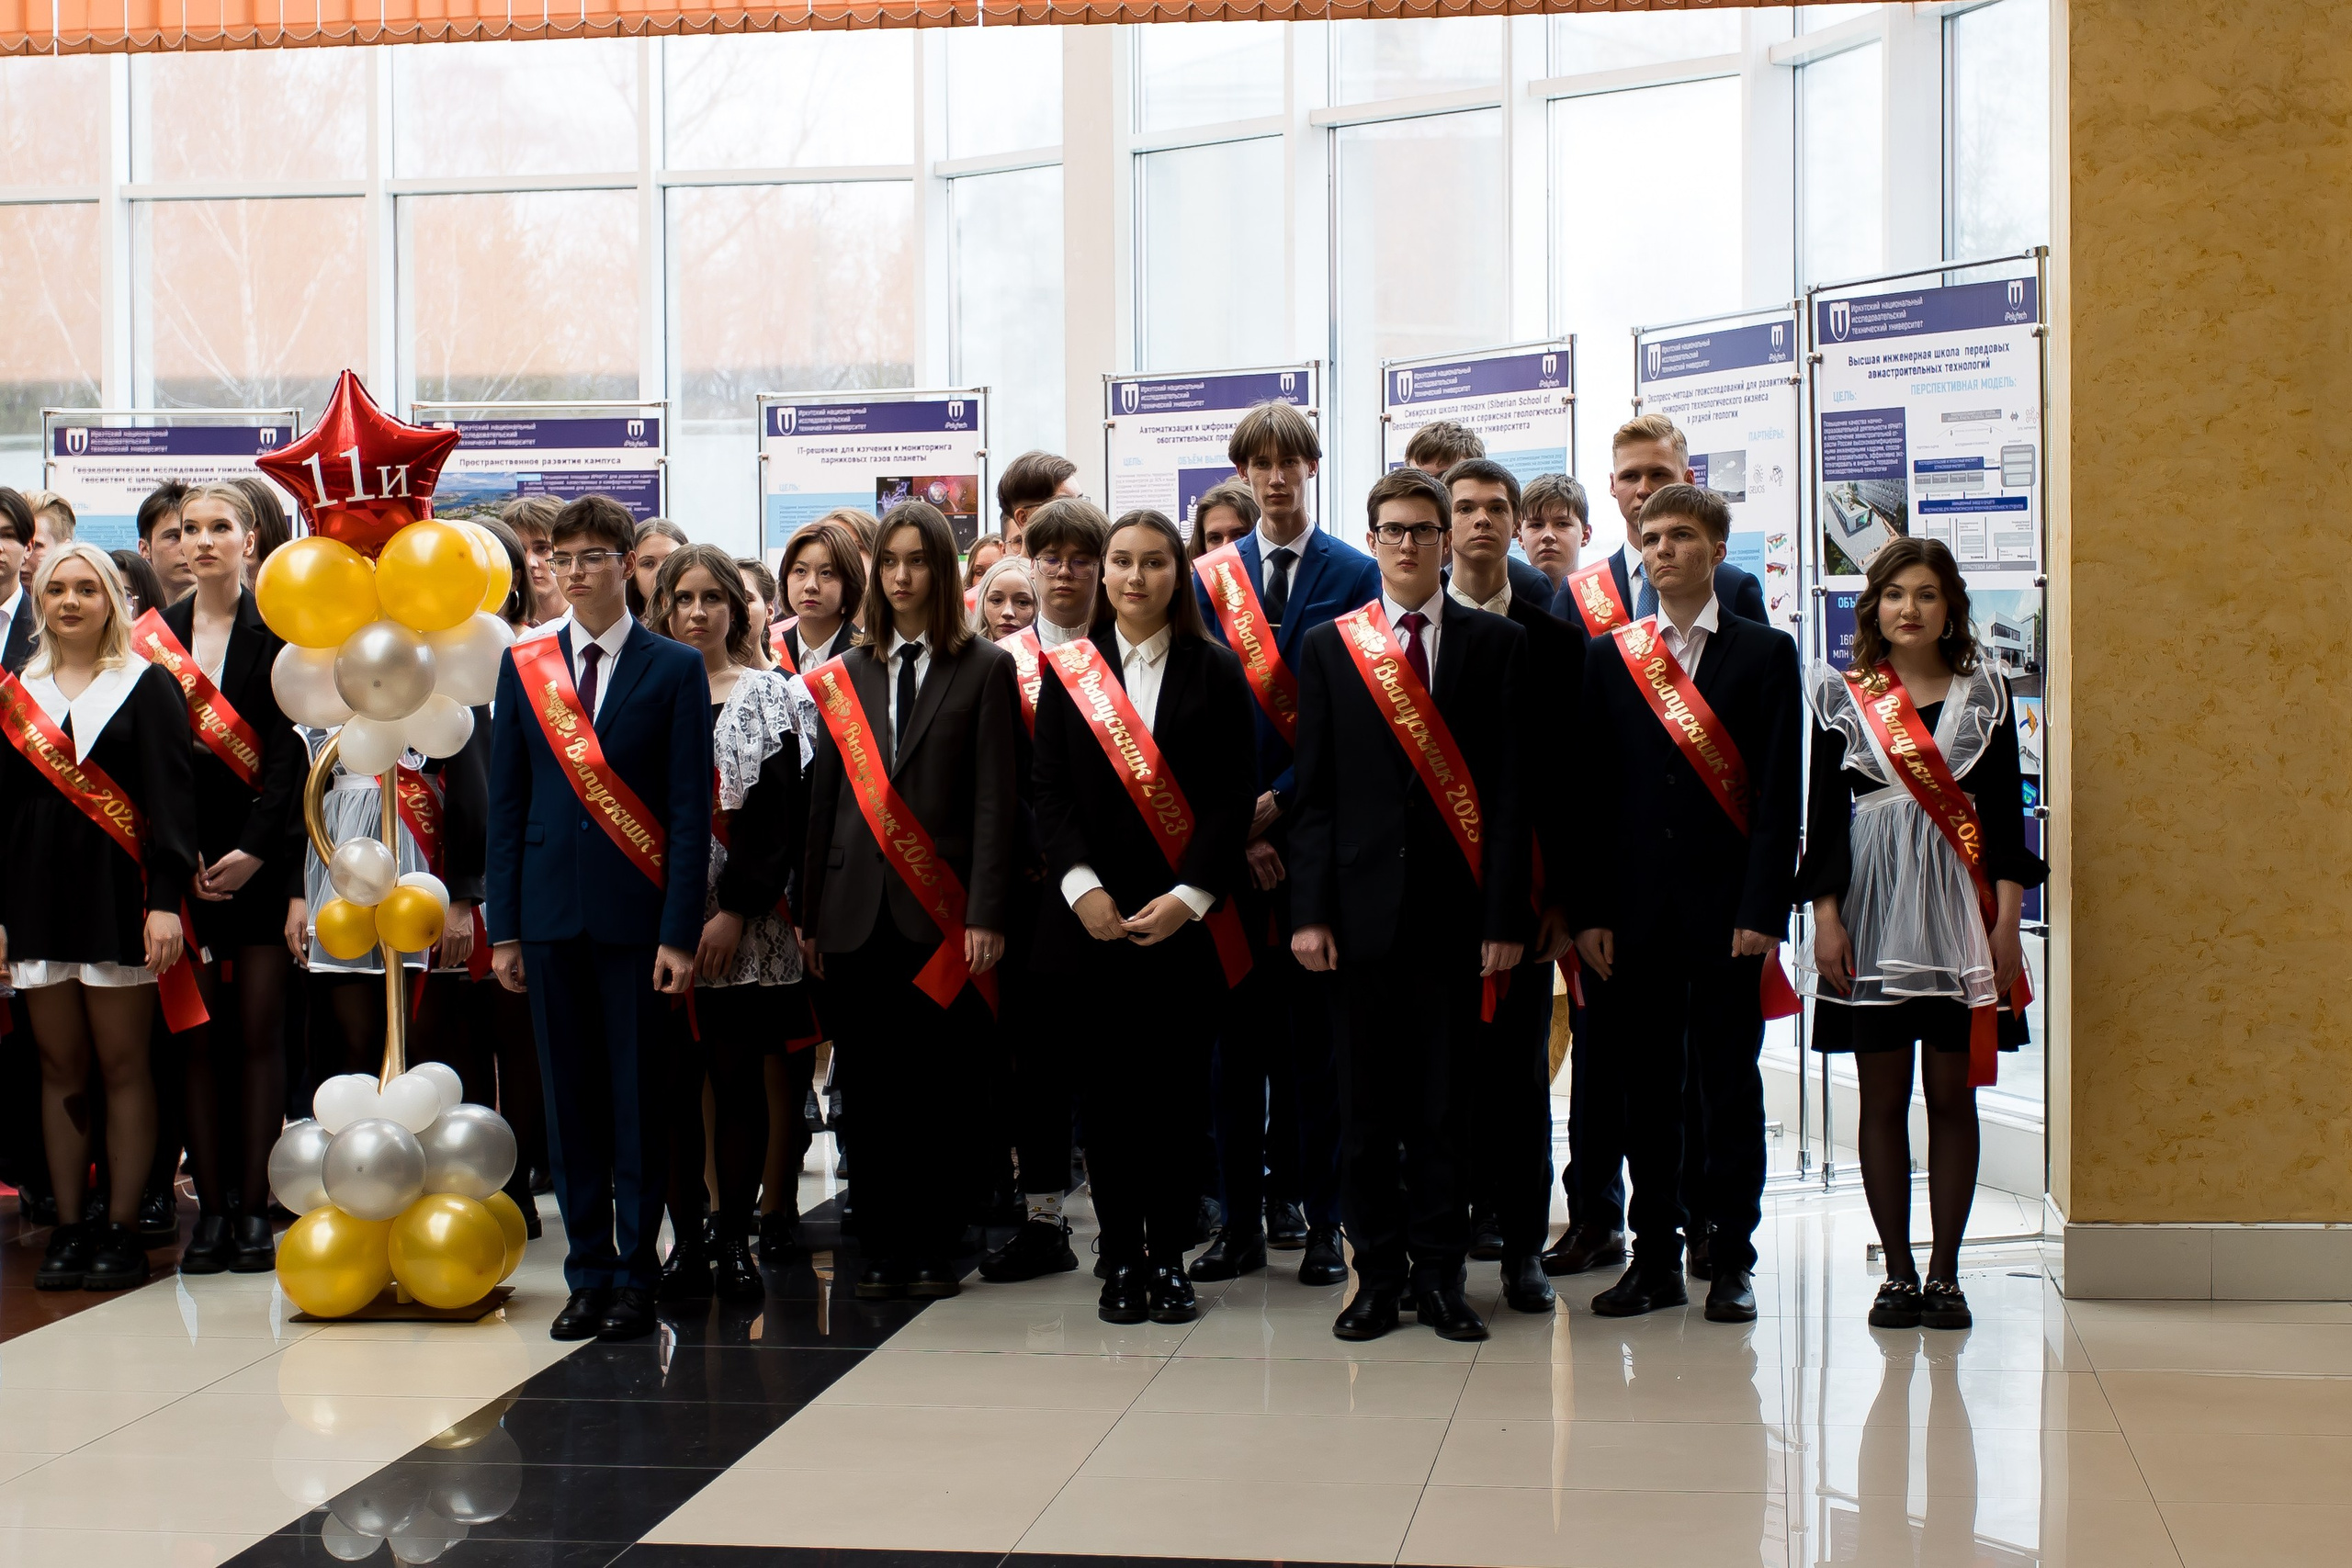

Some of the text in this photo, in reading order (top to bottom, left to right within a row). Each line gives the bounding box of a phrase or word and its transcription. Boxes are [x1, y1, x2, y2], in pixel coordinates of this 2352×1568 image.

[1850, 296, 1924, 313] Иркутский национальный
[1850, 309, 1907, 323] исследовательский
[2005, 310, 2028, 323] iPolytech
[1851, 320, 1924, 335] технический университет
[1848, 342, 2010, 367] Высшая инженерная школа передовых
[1868, 356, 1991, 380] авиастроительных технологий
[1647, 389, 1693, 404] Экспресс-методы
[1694, 380, 1745, 397] геоисследований
[1746, 380, 1757, 391] для
[1911, 376, 2018, 396] ПЕРСПЕКТИВНАЯ МОДЕЛЬ:
[1691, 396, 1742, 412] технологического
[1744, 392, 1770, 404] бизнеса
[1832, 389, 1858, 402] ЦЕЛЬ:
[1404, 408, 1437, 418] Сибирская
[1439, 406, 1459, 414] школа
[1487, 399, 1517, 410] (Siberian
[1518, 394, 1542, 406] School
[1544, 393, 1551, 404] of
[1477, 412, 1512, 423] сервисная
[1513, 406, 1566, 419] геологическая
[1692, 410, 1711, 425] рудной
[1713, 410, 1738, 421] геологии
[1139, 424, 1193, 434] Автоматизация
[1485, 423, 1531, 434] университета
[1747, 426, 1786, 442] ПАРТНЁРЫ:
[1156, 434, 1214, 445] обогатительных
[797, 446, 838, 456] IT-решение
[841, 446, 854, 455] для
[856, 446, 892, 456] изучения
[901, 445, 952, 454] мониторинга
[820, 456, 867, 465] парниковых
[893, 455, 927, 463] планеты
[217, 467, 262, 475] уникальн
[1832, 649, 1849, 659] МЛН
[1233, 610, 1297, 724] Выпускник
[1373, 657, 1455, 786] Выпускник
[1643, 657, 1729, 775] Выпускник
[1077, 670, 1189, 837] Выпускник 2023
[1873, 694, 1952, 811] Выпускник
[842, 720, 902, 837] Выпускник
[564, 737, 656, 853] Выпускник
